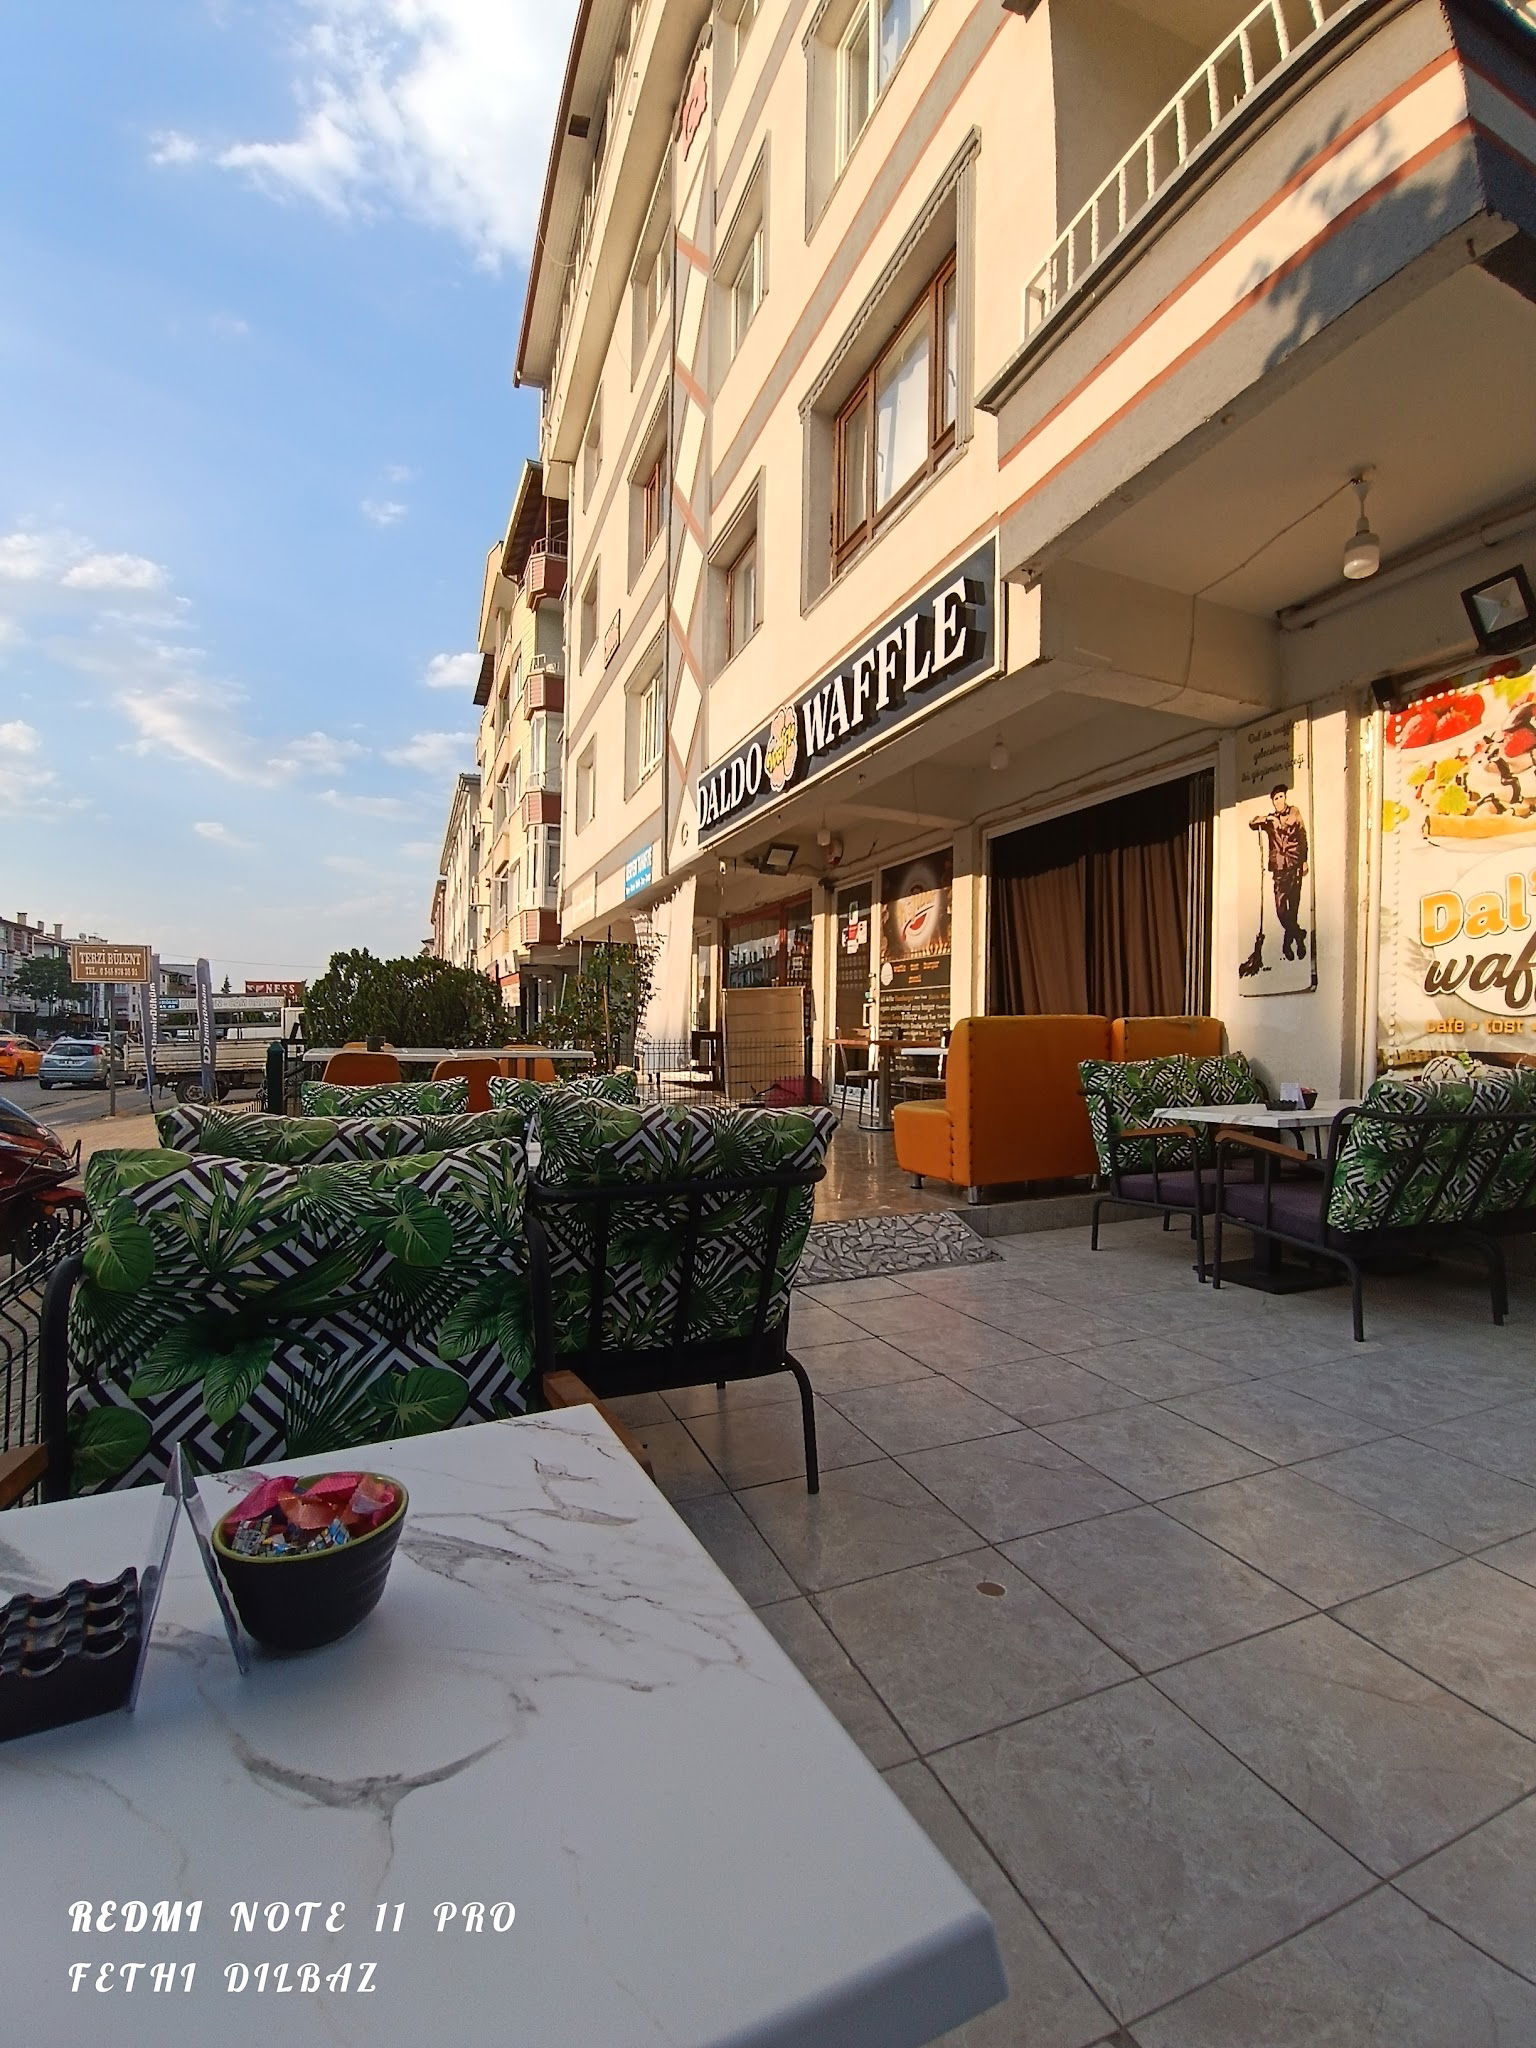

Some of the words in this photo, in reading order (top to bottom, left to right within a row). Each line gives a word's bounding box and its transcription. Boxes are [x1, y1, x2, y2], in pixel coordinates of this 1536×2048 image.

[698, 742, 763, 829] DALDO
[803, 577, 967, 757] WAFFLE
[79, 949, 106, 964] TERZİ
[107, 949, 141, 965] BÜLENT
[1424, 930, 1536, 1010] waf
[1485, 1018, 1523, 1033] tost
